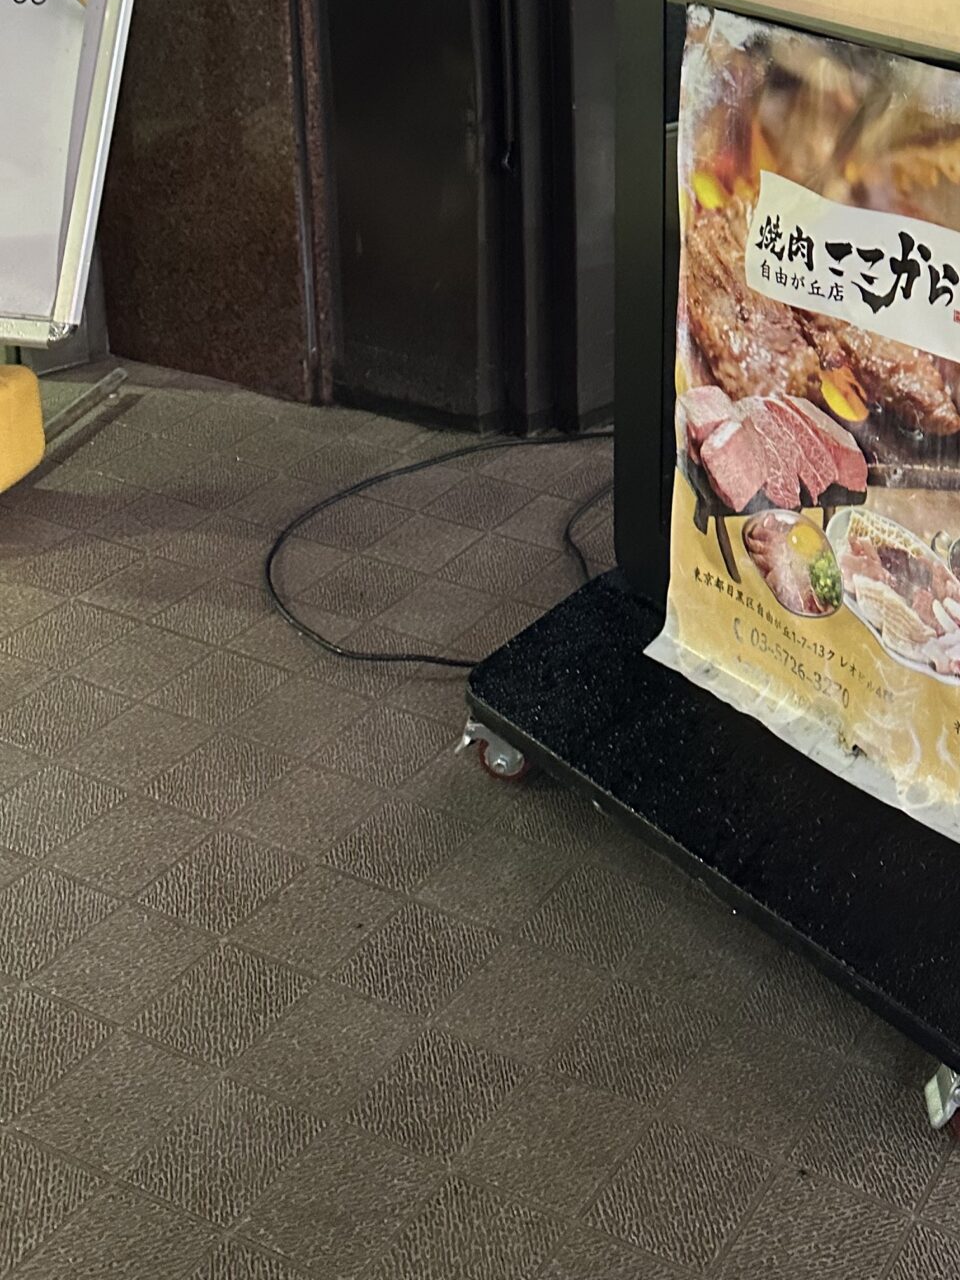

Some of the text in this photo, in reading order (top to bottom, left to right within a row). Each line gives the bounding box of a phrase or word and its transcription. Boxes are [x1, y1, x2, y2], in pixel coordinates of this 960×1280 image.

[760, 259, 845, 302] 自由が丘店
